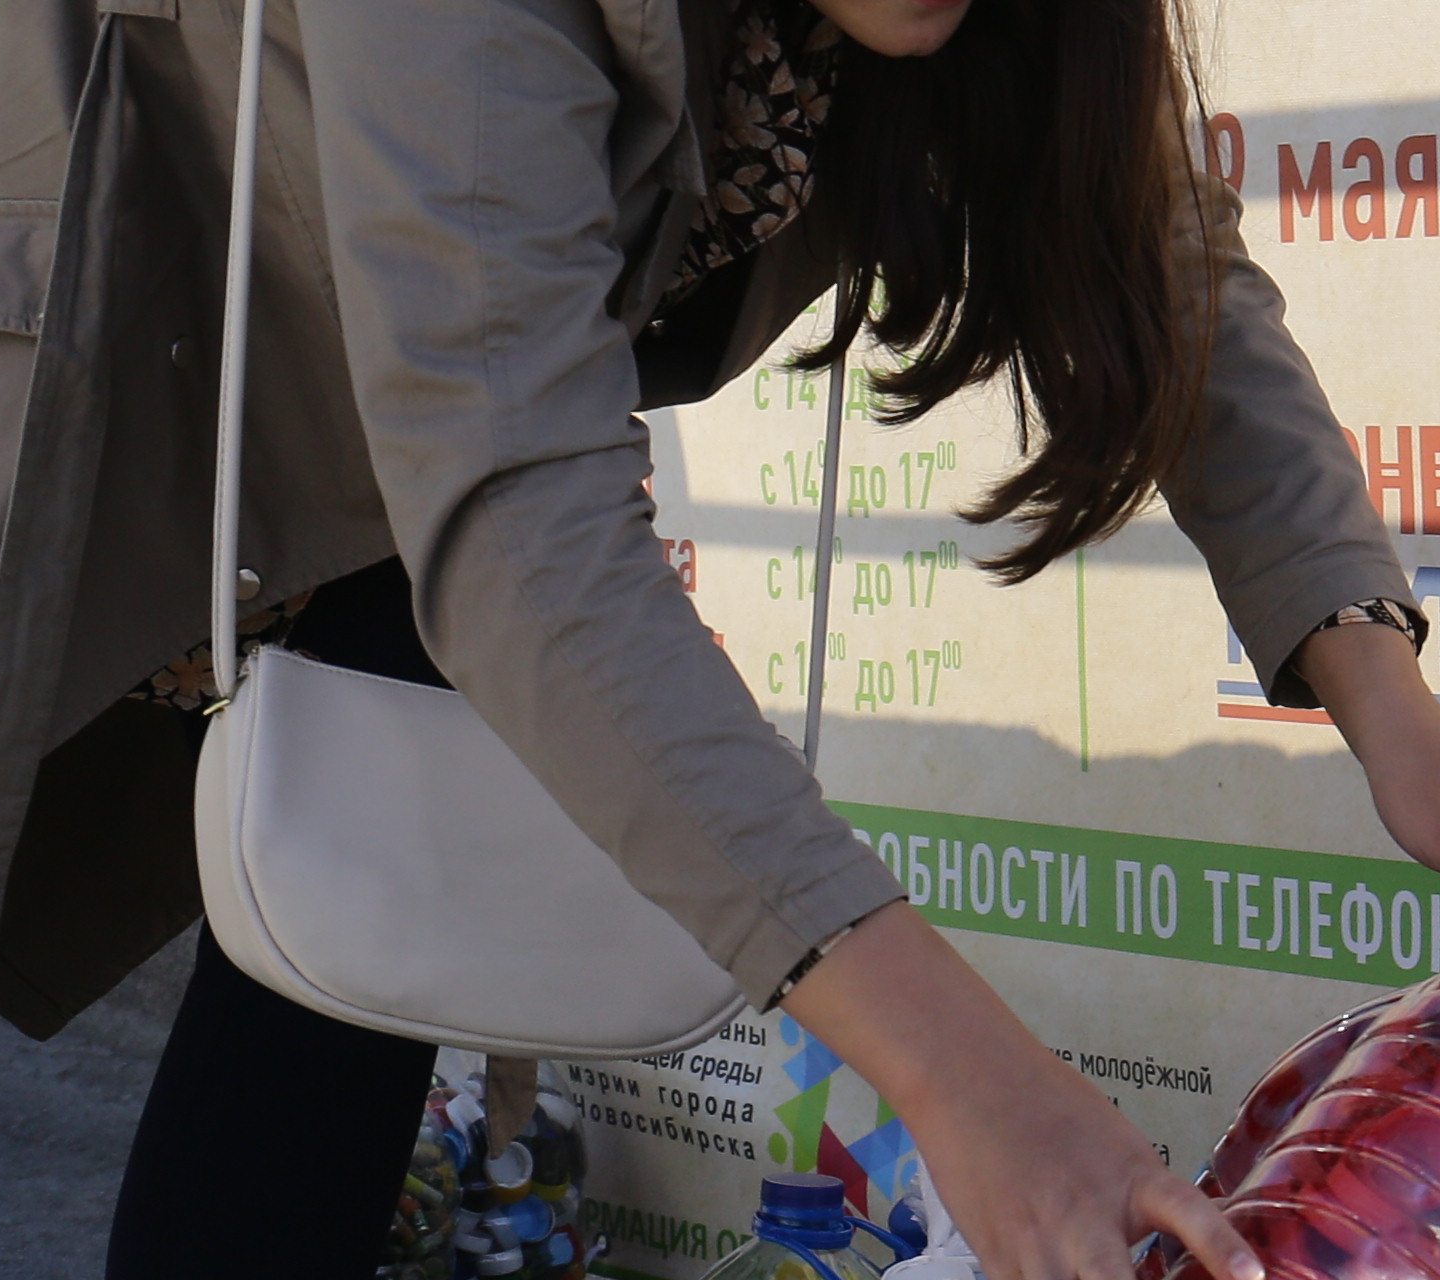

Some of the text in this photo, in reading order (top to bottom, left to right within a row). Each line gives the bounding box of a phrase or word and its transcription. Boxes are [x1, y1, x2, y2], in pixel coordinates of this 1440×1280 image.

[1277, 134, 1440, 243] мая
[761, 463, 776, 505] с
[847, 465, 887, 518] до
[767, 558, 782, 600] с
[853, 563, 892, 615] до
[768, 652, 783, 694] с
[855, 659, 895, 713] до
[1116, 859, 1177, 939] ПО
[719, 1022, 766, 1047] аны
[568, 1063, 754, 1123] мэрии города
[689, 1054, 762, 1086] среды
[1080, 1056, 1212, 1095] молодёжной
[573, 1093, 756, 1161] Новосибирска
[582, 1197, 708, 1260] РМАЦИЯ
